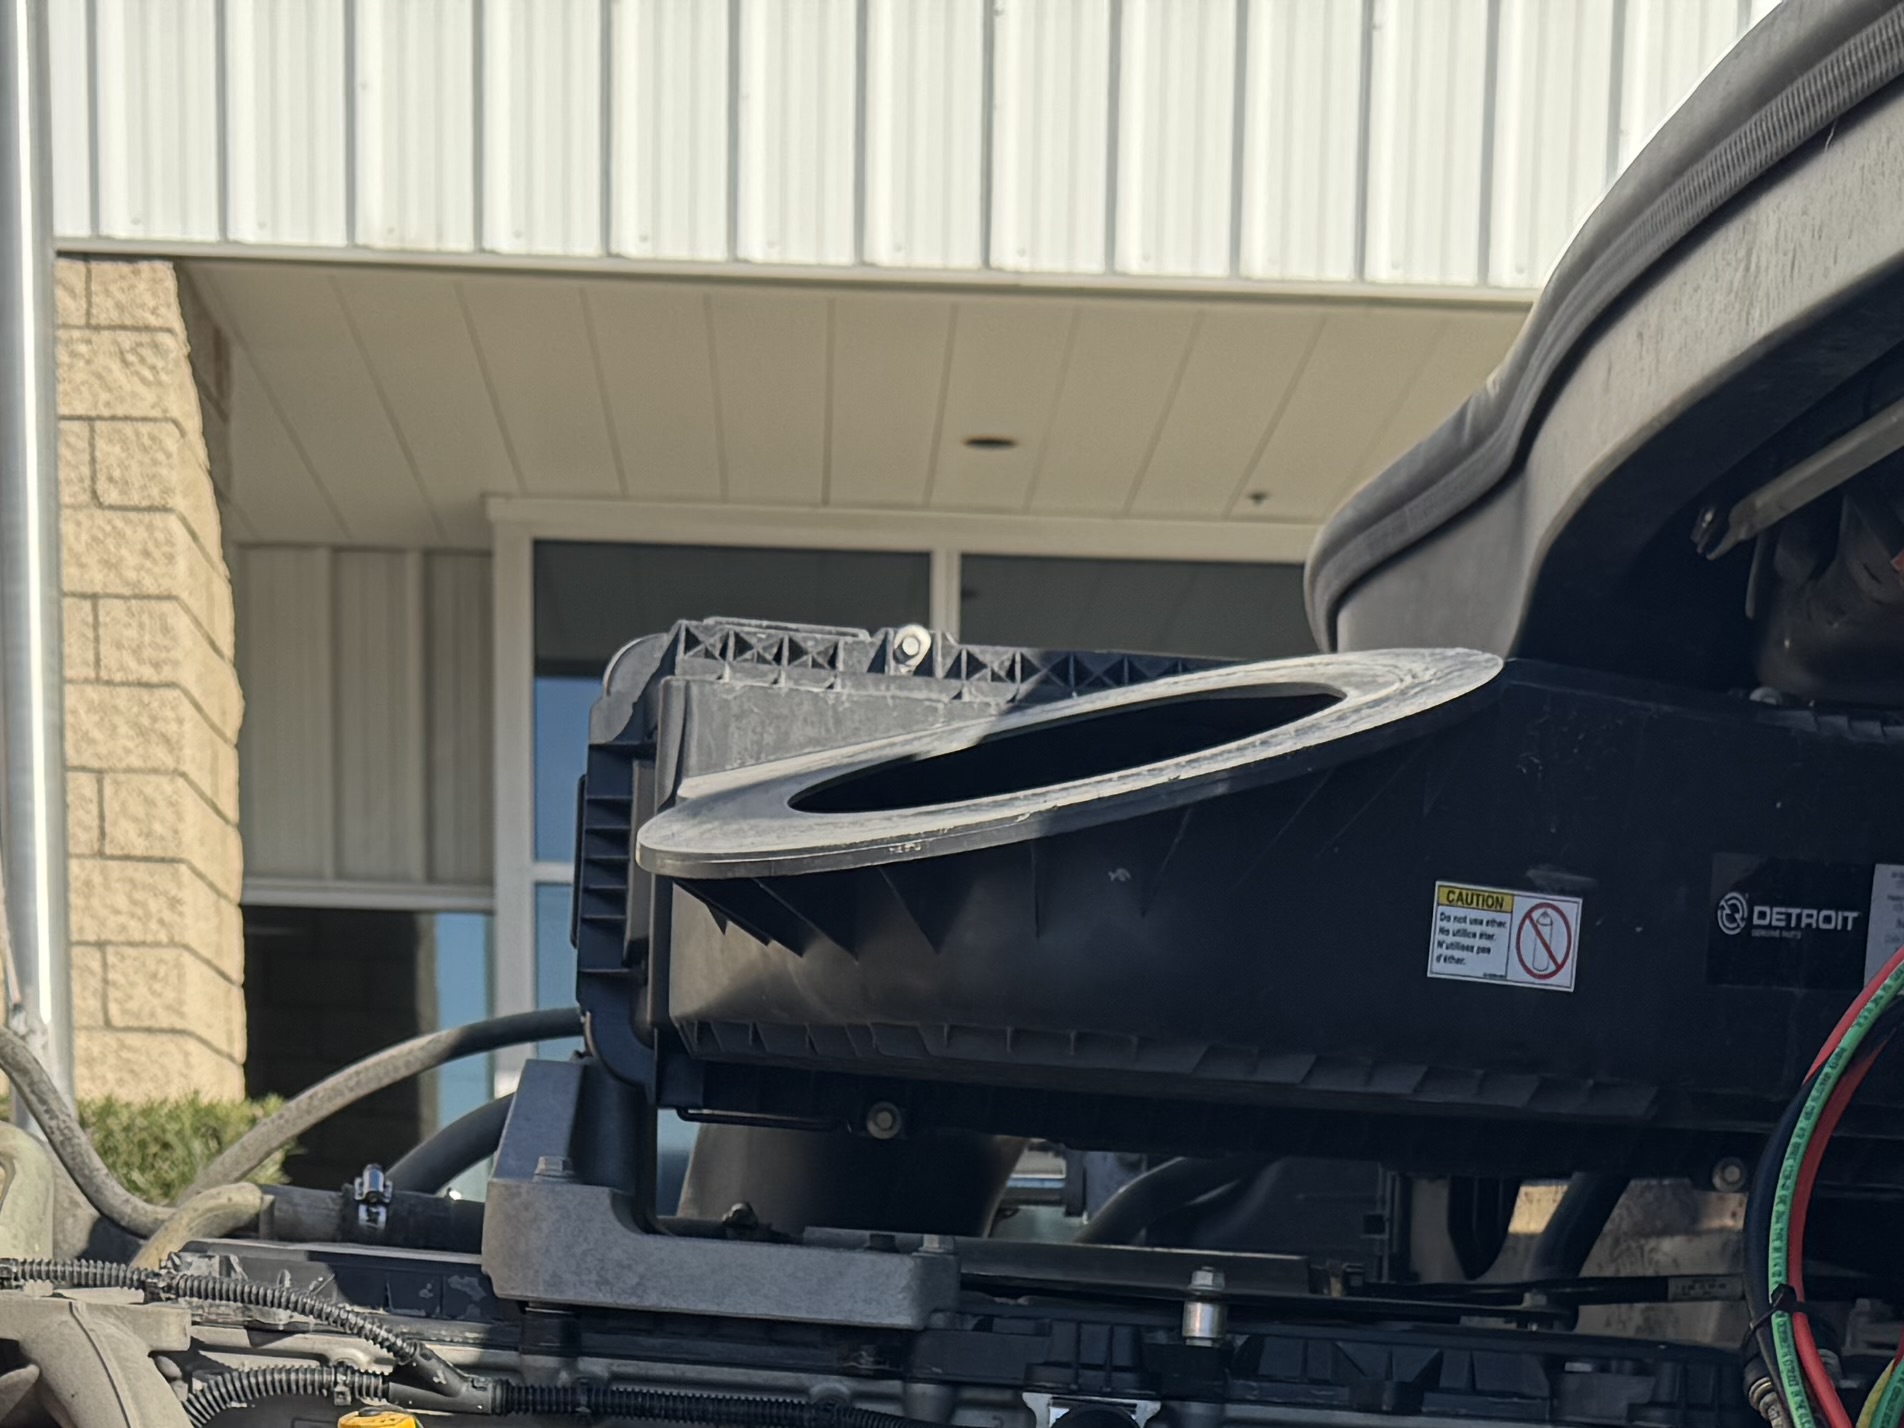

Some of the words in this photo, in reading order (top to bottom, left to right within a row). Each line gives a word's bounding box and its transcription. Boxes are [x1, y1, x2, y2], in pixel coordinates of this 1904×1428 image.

[1446, 890, 1504, 910] CAUTION
[1440, 912, 1451, 922] Do
[1452, 914, 1467, 923] not
[1753, 905, 1860, 930] DETROIT
